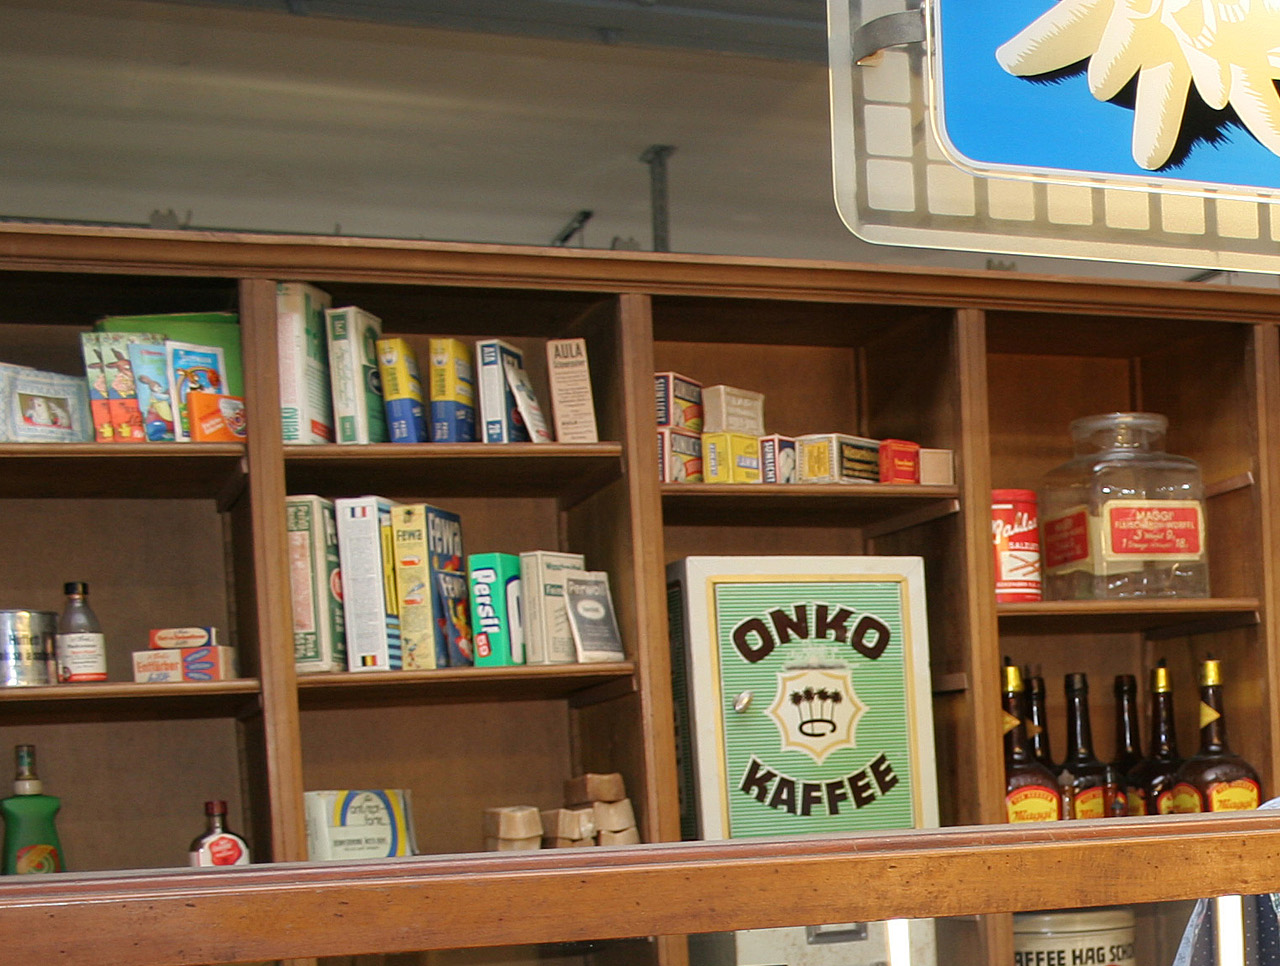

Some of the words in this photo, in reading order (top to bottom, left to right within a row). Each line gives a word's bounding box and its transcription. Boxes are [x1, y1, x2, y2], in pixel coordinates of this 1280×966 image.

[554, 342, 583, 358] AULA
[471, 566, 501, 634] Persil
[732, 603, 892, 664] ONKO
[739, 752, 900, 817] KAFFEE
[1072, 947, 1105, 966] HAG
